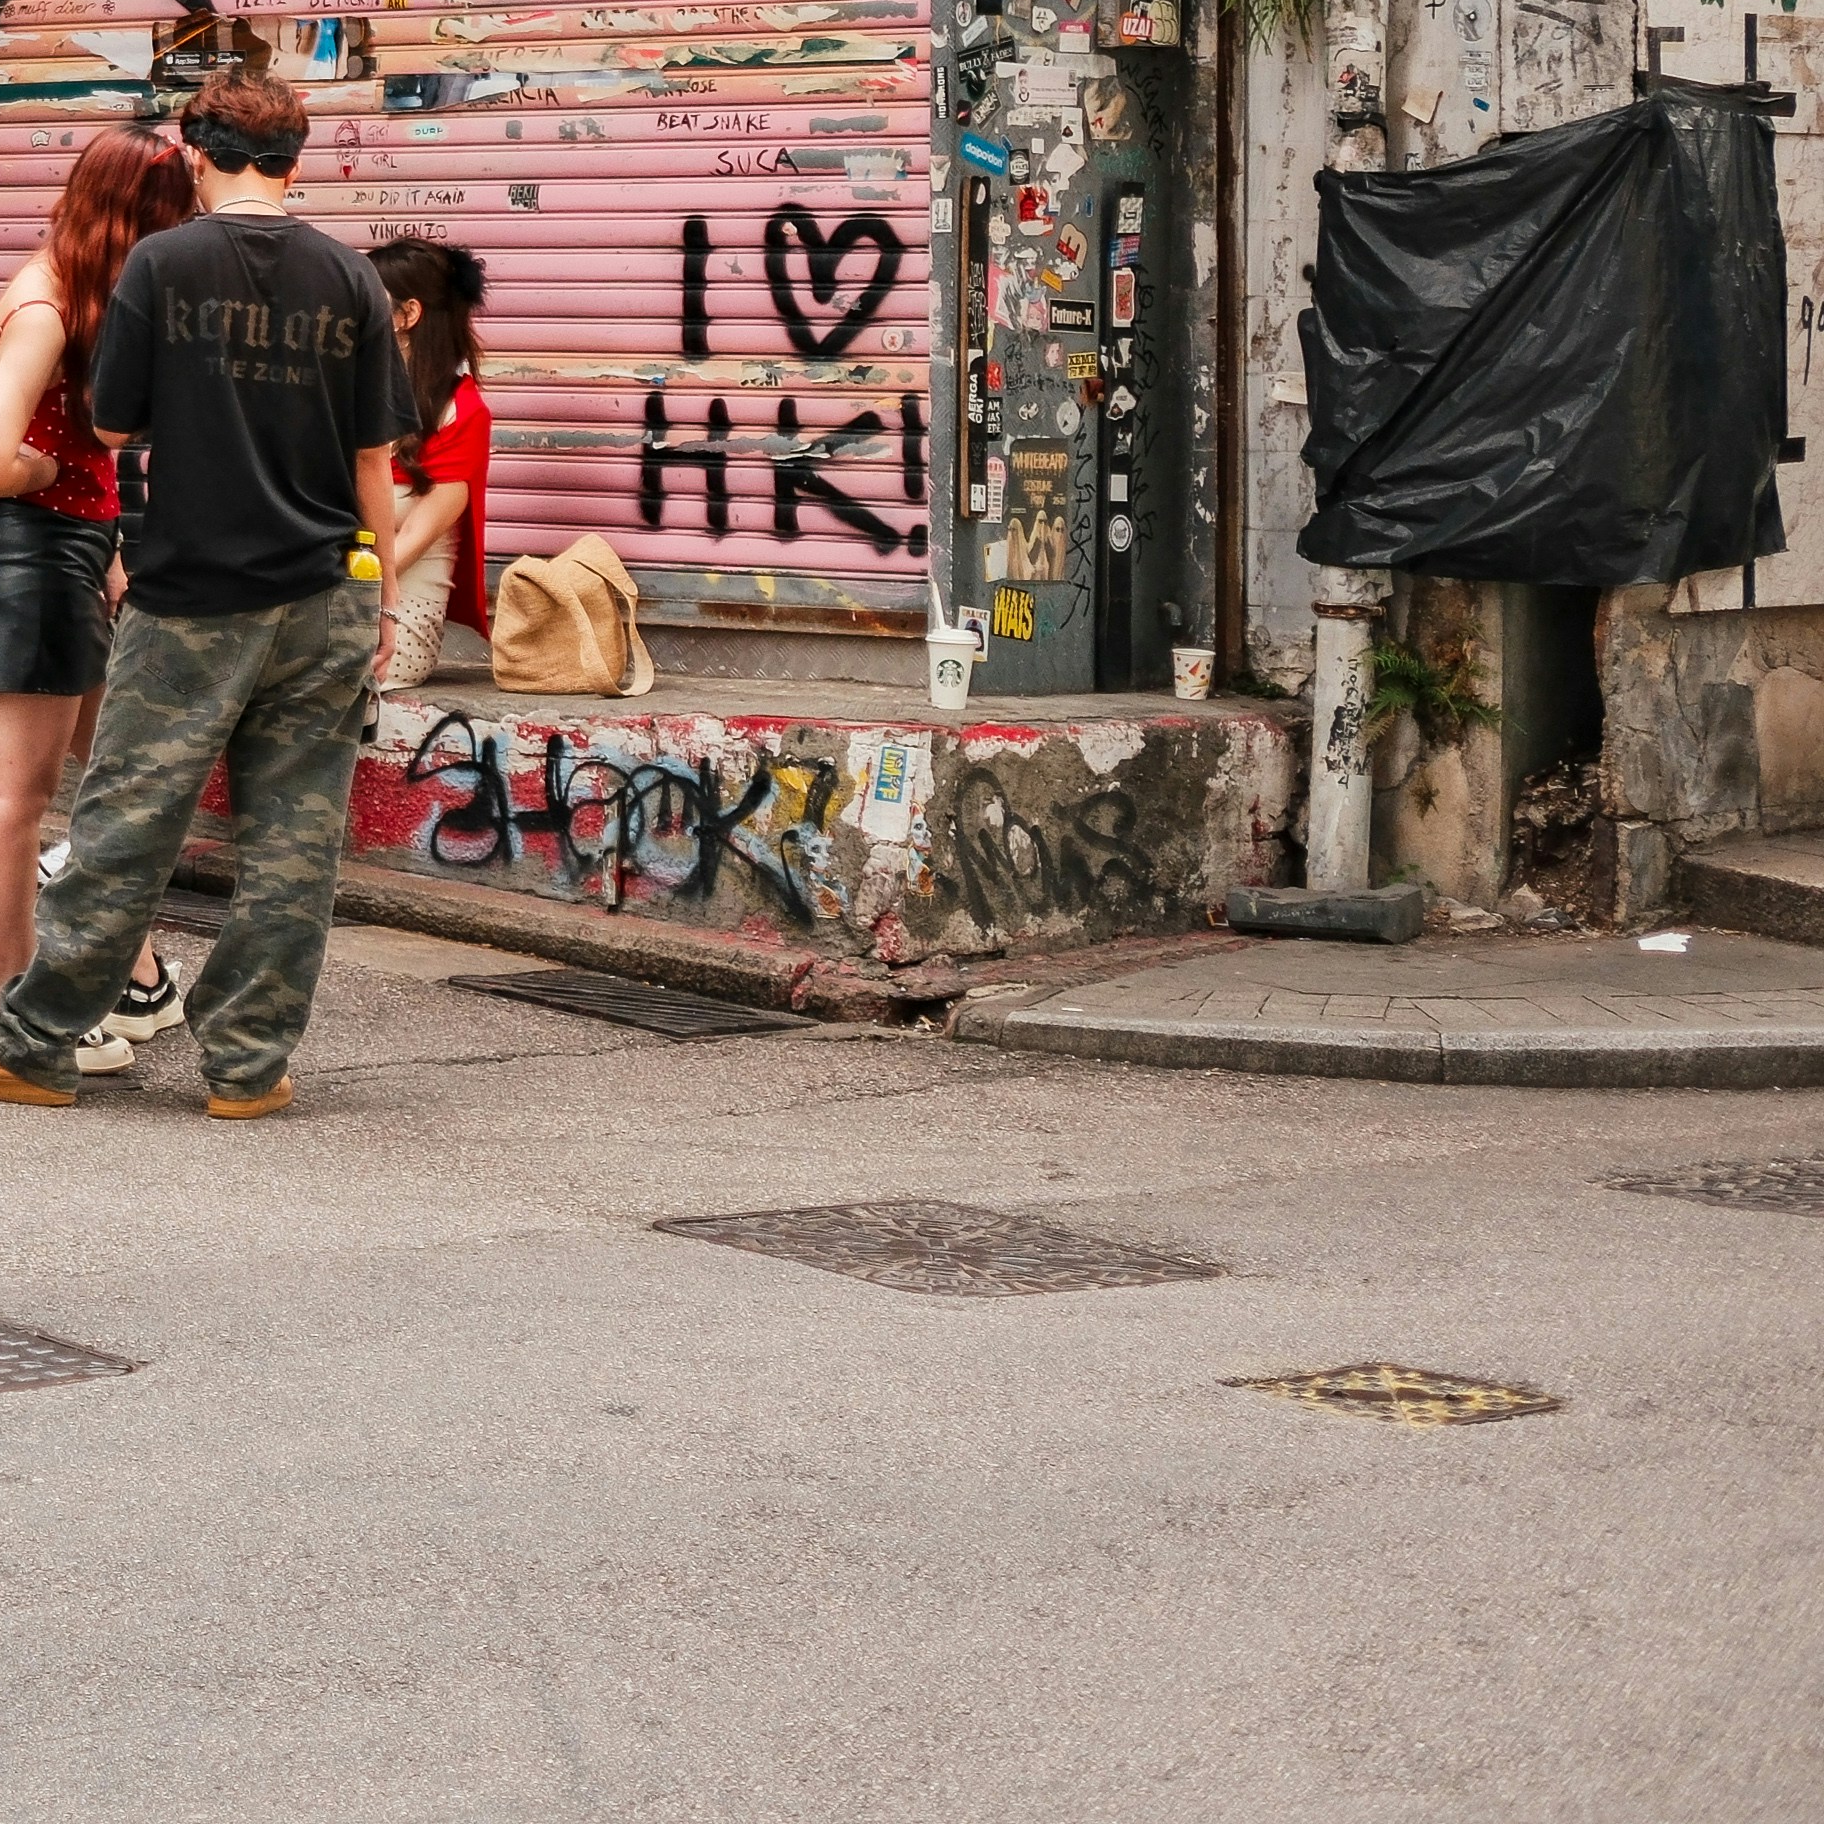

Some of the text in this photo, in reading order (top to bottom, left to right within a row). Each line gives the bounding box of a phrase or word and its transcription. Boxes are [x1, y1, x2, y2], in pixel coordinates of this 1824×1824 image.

[1122, 18, 1151, 37] UZAI
[656, 112, 771, 132] BEAT SNAKE
[709, 147, 801, 176] SUCA
[1051, 306, 1092, 327] Future-X
[1067, 353, 1097, 366] XEME
